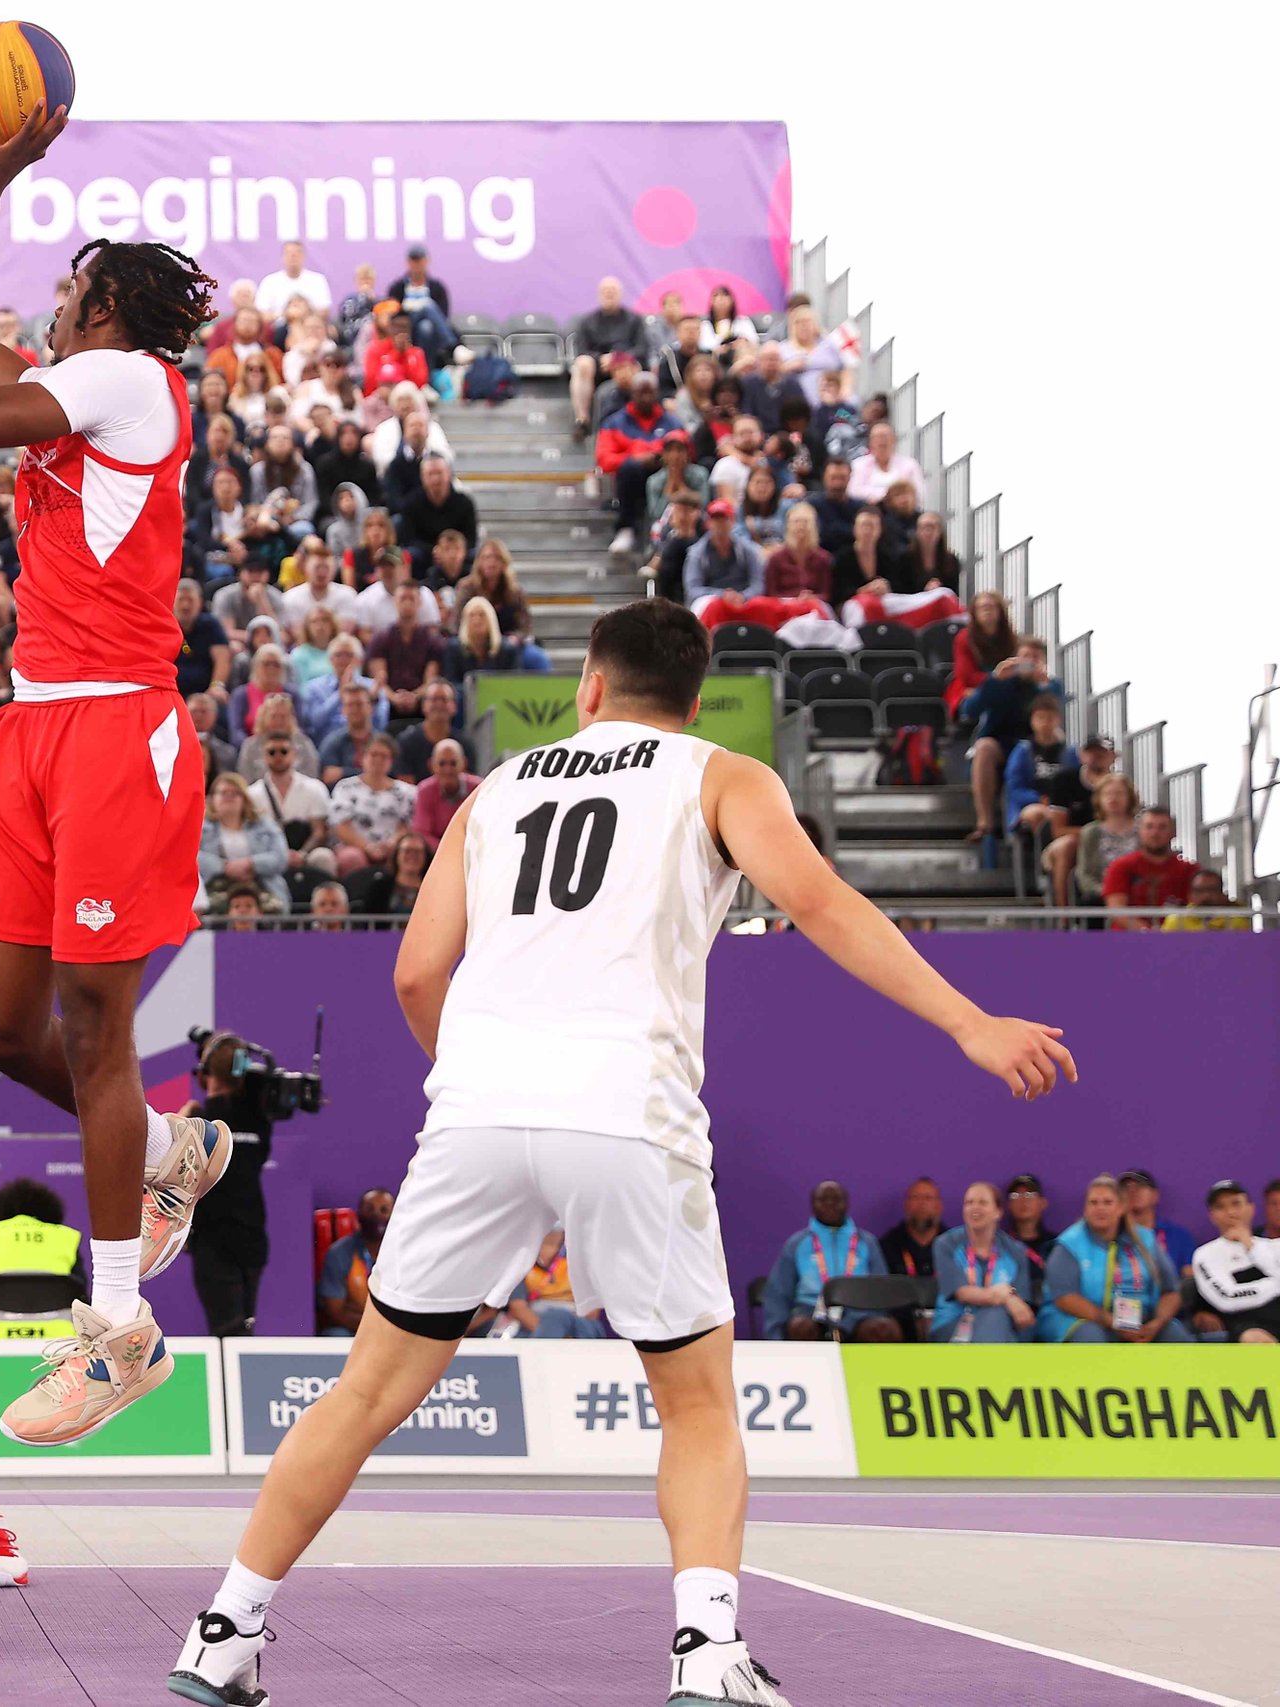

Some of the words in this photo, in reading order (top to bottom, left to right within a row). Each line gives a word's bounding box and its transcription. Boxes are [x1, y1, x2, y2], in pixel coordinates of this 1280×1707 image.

[11, 156, 535, 261] beginning
[517, 740, 660, 780] RODGER
[511, 797, 618, 915] 10
[420, 1374, 481, 1405] ust
[880, 1387, 1277, 1439] BIRMINGHAM
